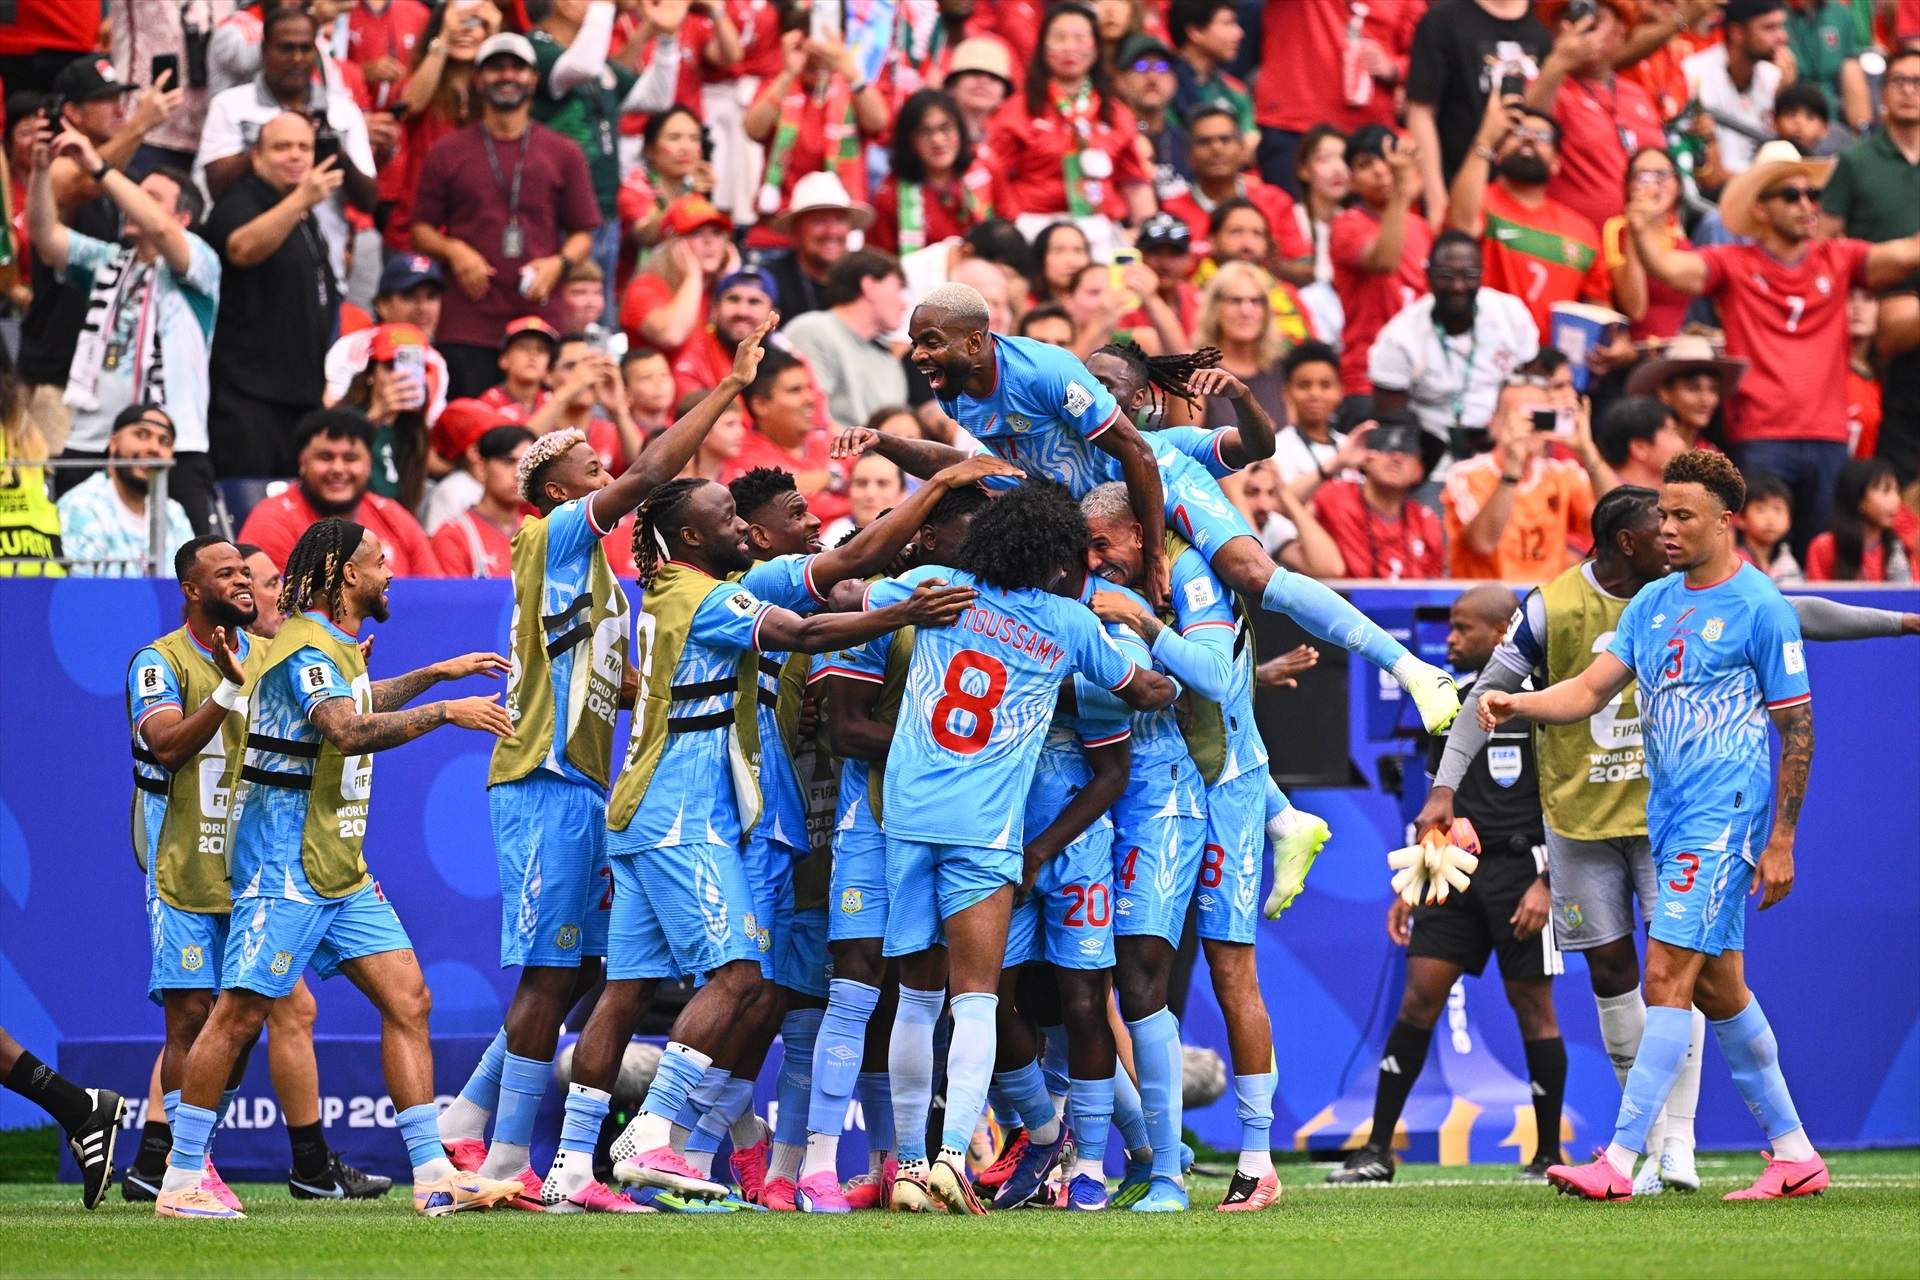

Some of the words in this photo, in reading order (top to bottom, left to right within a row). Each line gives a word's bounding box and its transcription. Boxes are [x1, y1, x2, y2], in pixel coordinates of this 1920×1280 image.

[1786, 296, 1806, 332] 7
[1518, 526, 1547, 561] 12
[951, 604, 1066, 672] TOUSSAMY
[1664, 638, 1686, 680] 3
[590, 678, 611, 699] ORLD
[931, 648, 1008, 756] 8
[1613, 723, 1642, 738] FIFA
[1590, 750, 1635, 765] WORLD
[806, 815, 834, 830] ORLD
[1119, 847, 1141, 891] 4
[1200, 842, 1226, 889] 8
[1668, 852, 1701, 894] 3
[1062, 882, 1112, 928] 20
